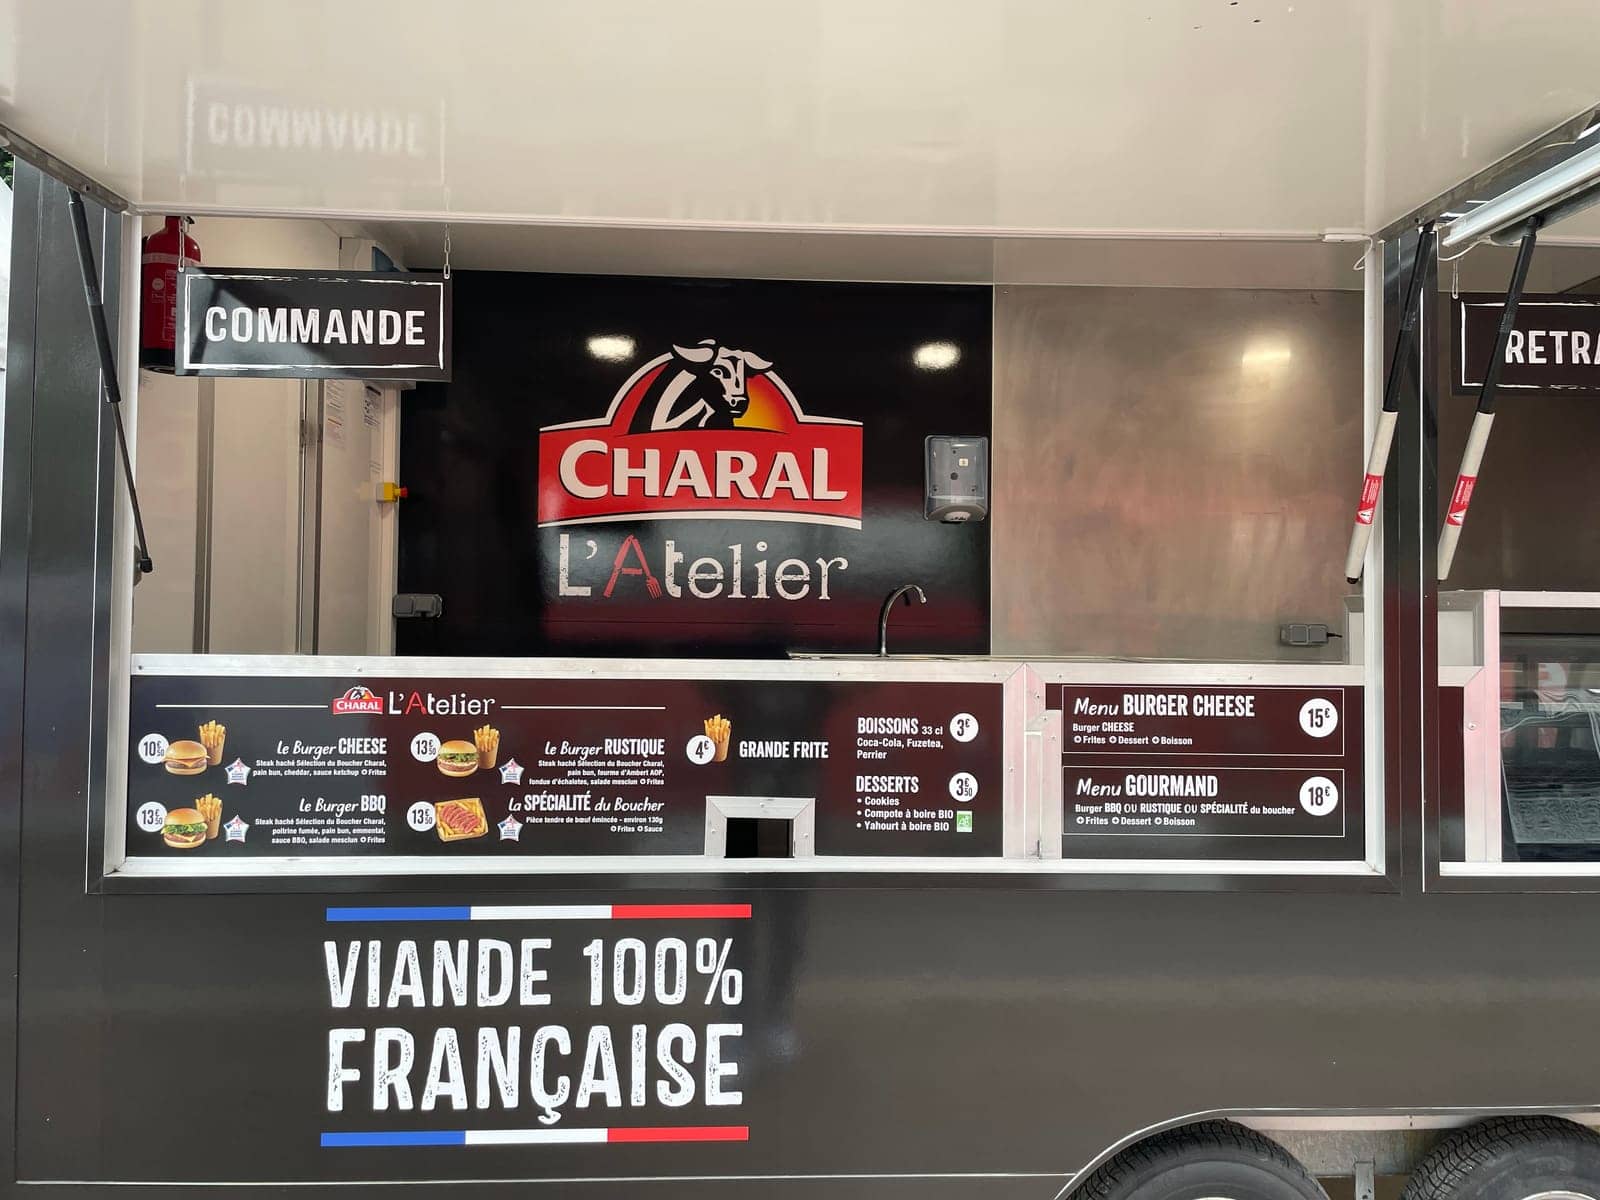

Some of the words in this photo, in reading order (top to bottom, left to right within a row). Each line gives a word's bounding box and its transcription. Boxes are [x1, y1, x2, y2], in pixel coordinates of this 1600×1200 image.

[205, 306, 426, 345] COMMANDE
[558, 439, 848, 502] CHARAL
[558, 533, 848, 601] L'Atelier
[336, 701, 380, 710] CHARAL
[389, 691, 495, 715] L'Atelier
[1073, 697, 1119, 716] Menu
[1123, 694, 1188, 716] BURGER
[1192, 695, 1255, 717] CHEESE
[857, 717, 919, 735] BOISSONS
[921, 726, 933, 735] 33
[935, 726, 943, 735] cl
[956, 718, 970, 736] 3€
[1072, 723, 1100, 733] Burger
[1101, 722, 1135, 733] CHEESE
[1308, 708, 1330, 728] 15€
[277, 740, 289, 755] Le
[292, 740, 336, 760] Burger
[338, 738, 387, 755] CHEESE
[544, 741, 557, 755] Le
[560, 741, 603, 760] Burger
[604, 738, 665, 758] RUSTIQUE
[695, 740, 710, 759] 4€
[739, 741, 790, 758] GRANDE
[793, 741, 829, 758] FRITE
[857, 738, 904, 749] Coca-Cola,
[906, 738, 944, 750] Fuzetea,
[1083, 736, 1106, 744] Frites
[1118, 736, 1149, 744] Dessert
[1160, 736, 1193, 745] Boisson
[857, 750, 887, 759] Perrier
[856, 776, 919, 793] DESSERTS
[1076, 777, 1122, 796] Menu
[1125, 774, 1218, 797] GOURMAND
[508, 797, 522, 812] La
[524, 790, 592, 811] SPÉCIALITÉ
[594, 797, 611, 812] du
[614, 797, 664, 812] Boucher
[864, 797, 900, 806] Cookies
[1308, 786, 1330, 806] 18€
[299, 798, 312, 812] Le
[315, 797, 359, 817] Burger
[360, 795, 386, 815] BBQ
[864, 809, 904, 819] Compote
[905, 809, 912, 818] à
[913, 809, 936, 818] boire
[938, 810, 954, 819] BIO
[1075, 804, 1102, 814] Burger
[1104, 803, 1122, 814] BBQ
[1124, 803, 1137, 813] OU
[1140, 803, 1182, 814] RUSTIQUE
[1184, 803, 1198, 814] OU
[1200, 802, 1248, 814] SPÉCIALITÉ
[1250, 806, 1261, 814] du
[1263, 806, 1296, 815] boucher
[864, 821, 899, 831] Yahourt
[901, 821, 907, 831] à
[909, 821, 932, 831] boire
[934, 822, 950, 831] BIO
[1085, 817, 1108, 825] Frites
[1121, 817, 1151, 825] Dessert
[1163, 817, 1195, 826] Boisson
[323, 938, 552, 1008] VIANDE
[583, 938, 744, 1006] 100%
[326, 1023, 744, 1124] FRANÇAISE
